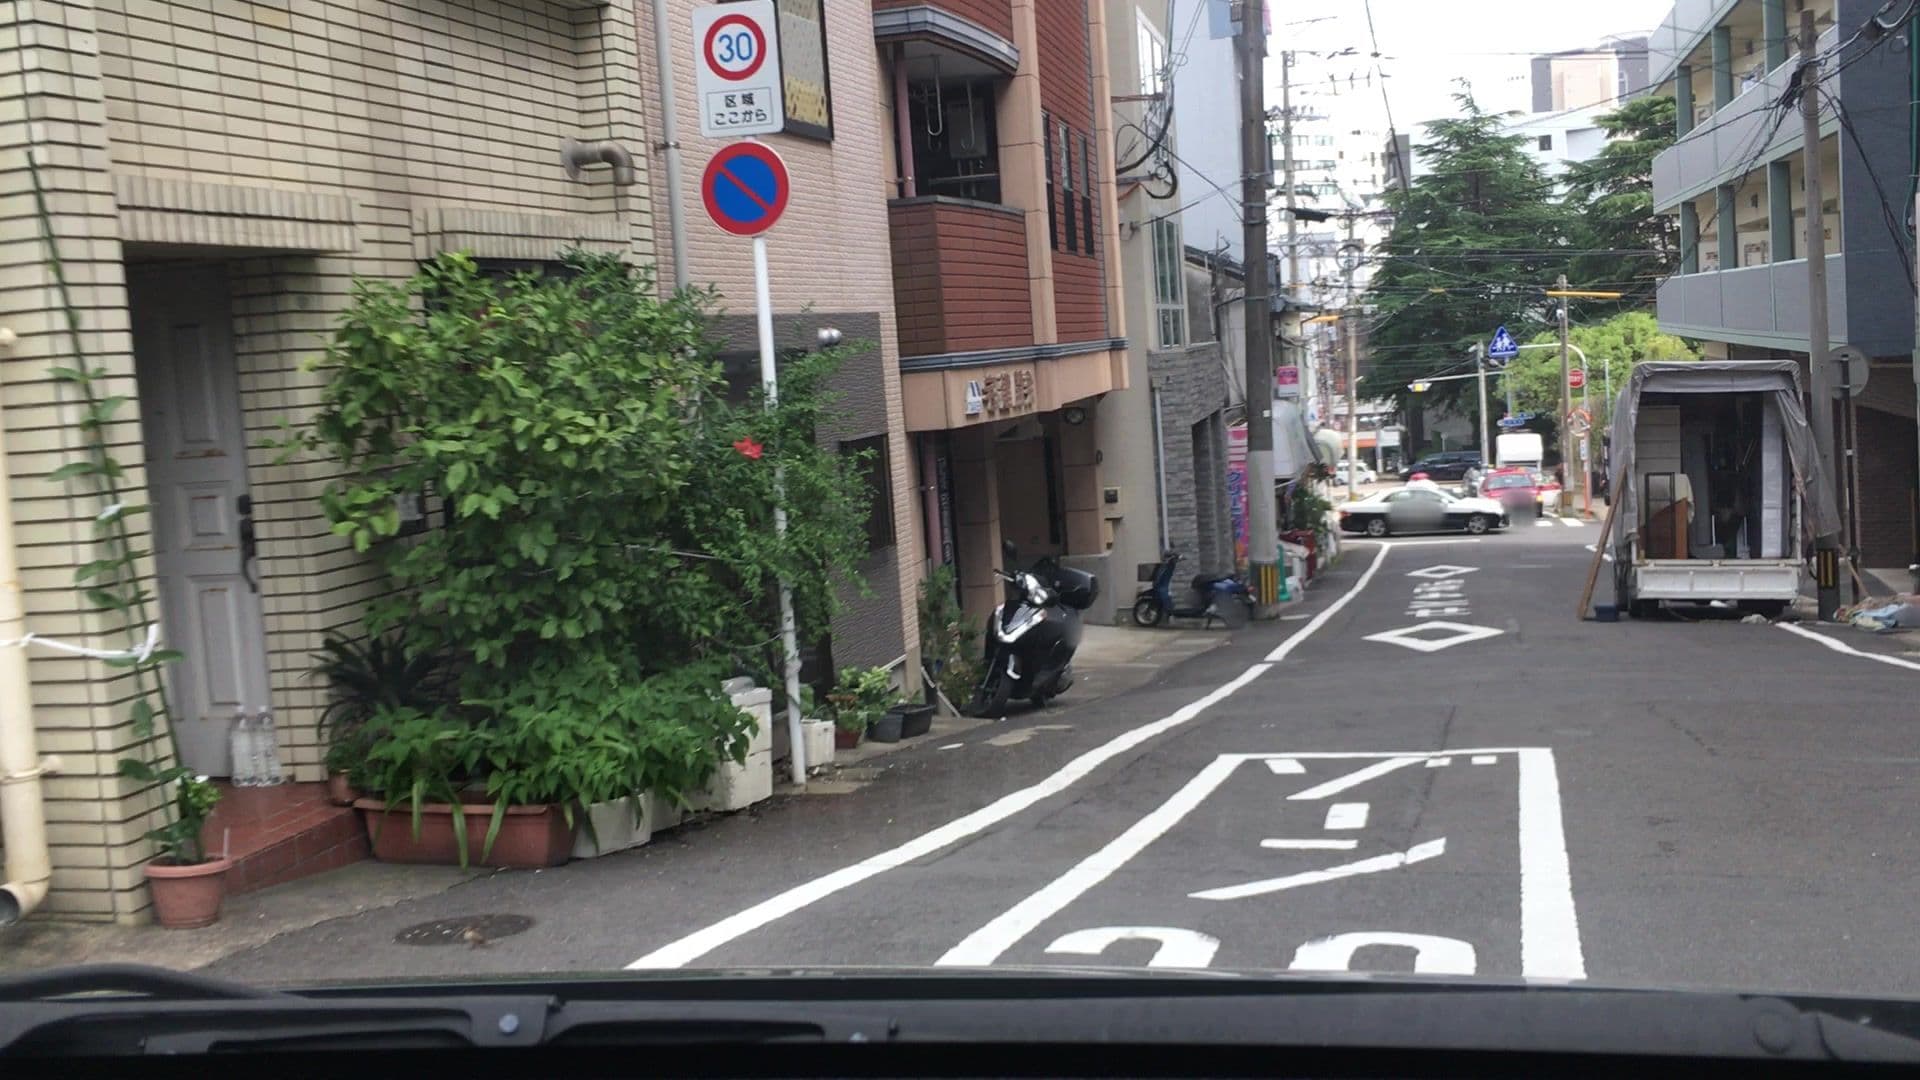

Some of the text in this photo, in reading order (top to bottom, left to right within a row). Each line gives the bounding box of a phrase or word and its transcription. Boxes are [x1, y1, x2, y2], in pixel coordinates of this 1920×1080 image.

[719, 32, 753, 63] 30
[724, 92, 755, 109] 区域
[715, 109, 767, 126] ここから
